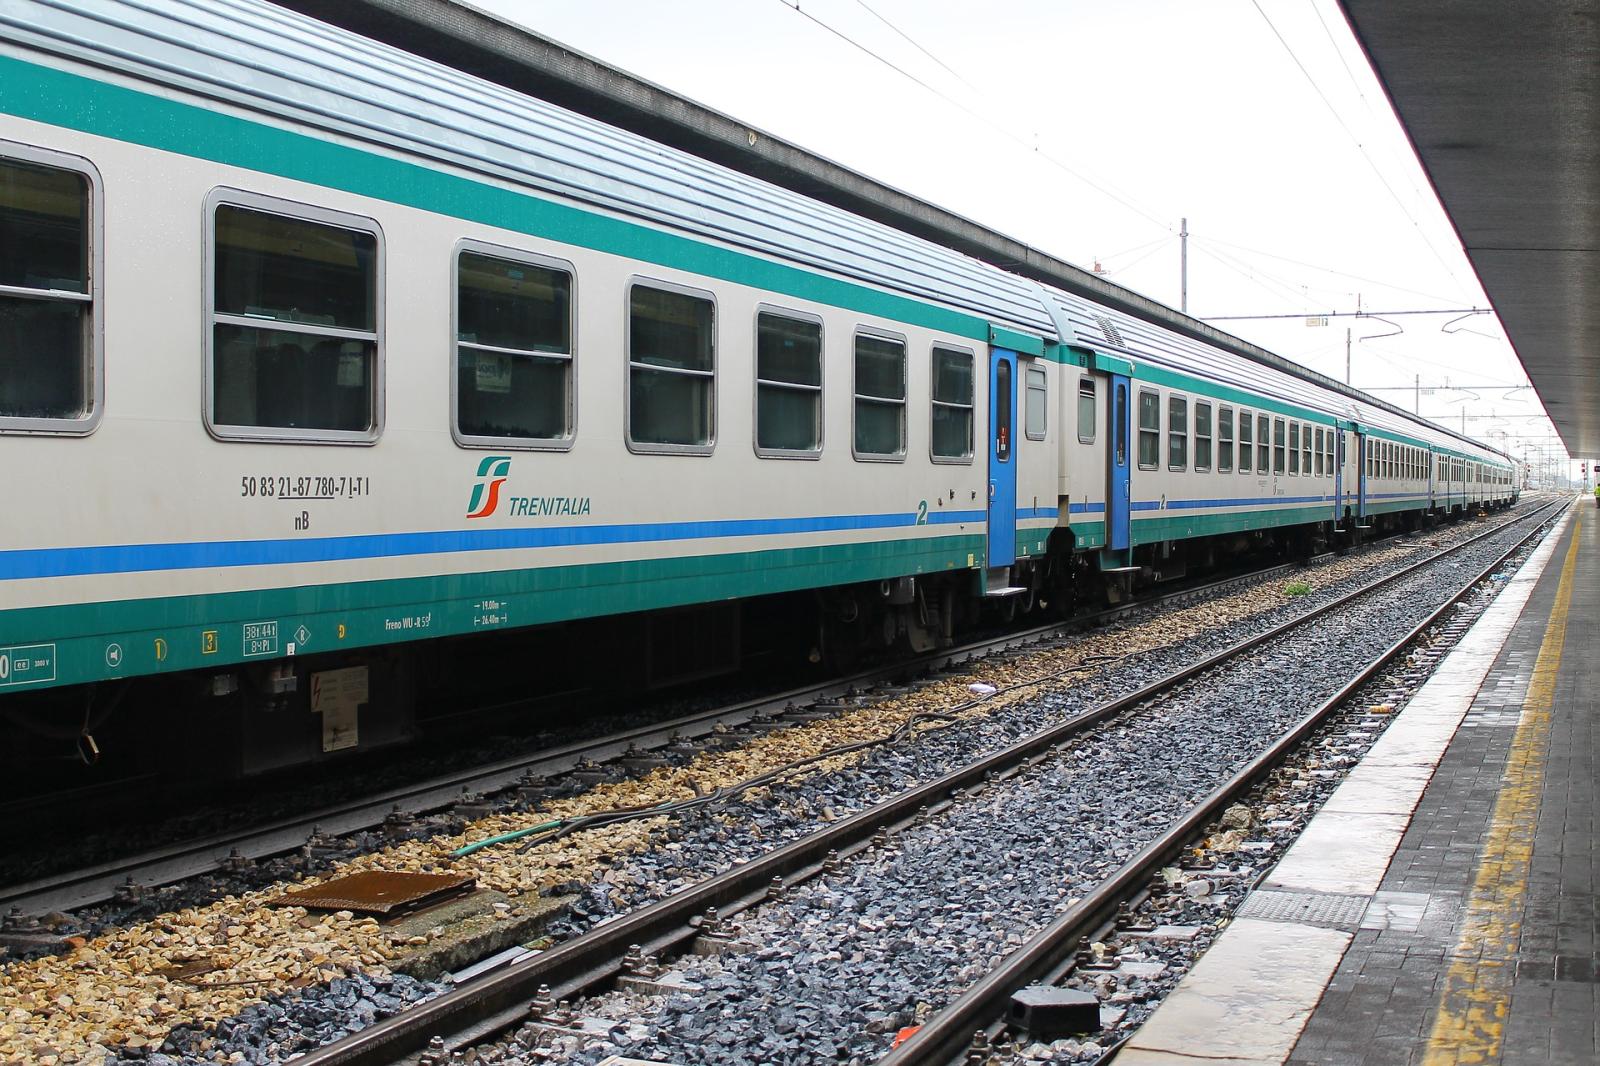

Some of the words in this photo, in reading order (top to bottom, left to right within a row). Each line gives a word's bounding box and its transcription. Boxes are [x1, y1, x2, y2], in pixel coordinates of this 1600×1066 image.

[241, 476, 256, 496] 50
[260, 476, 275, 496] 83
[510, 497, 590, 516] TRENITALIA
[916, 500, 928, 525] 2
[295, 511, 310, 530] nB
[385, 619, 401, 630] Freno
[300, 629, 305, 641] R
